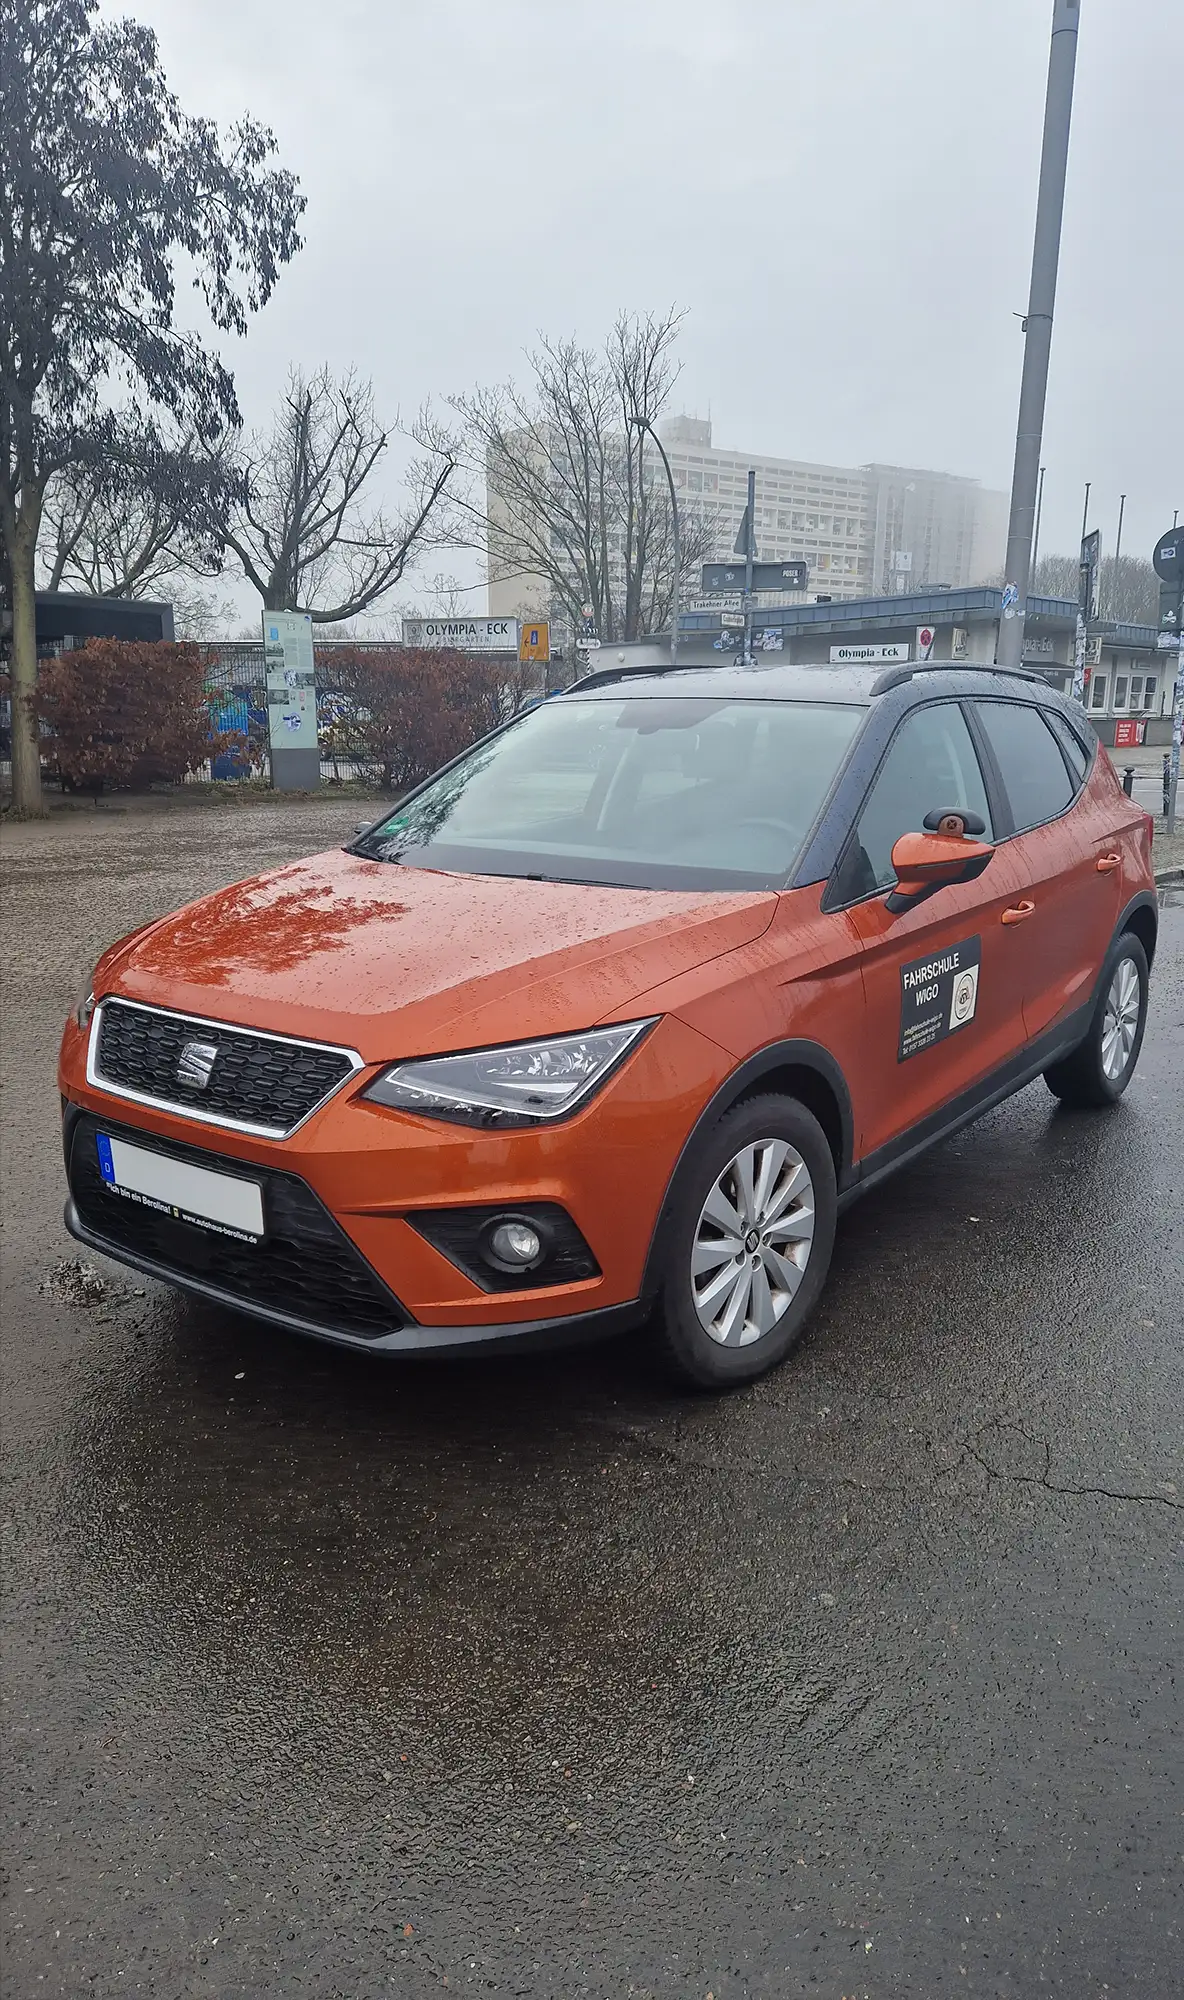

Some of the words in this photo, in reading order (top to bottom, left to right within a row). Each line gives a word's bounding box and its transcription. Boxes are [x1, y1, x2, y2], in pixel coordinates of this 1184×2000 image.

[693, 600, 722, 608] Trakehner
[723, 599, 739, 607] Allee
[426, 623, 477, 636] OLYMPIA
[487, 622, 509, 635] ECK
[838, 648, 875, 659] Olympia
[881, 647, 899, 657] Eck
[903, 952, 960, 990] FAHRSCHULE
[915, 983, 939, 1007] WIGO
[104, 1162, 111, 1173] D
[119, 1187, 131, 1199] bin
[131, 1192, 142, 1203] ein
[142, 1196, 171, 1214] Berolina!
[182, 1213, 257, 1244] www.autohaus-berolina.de
